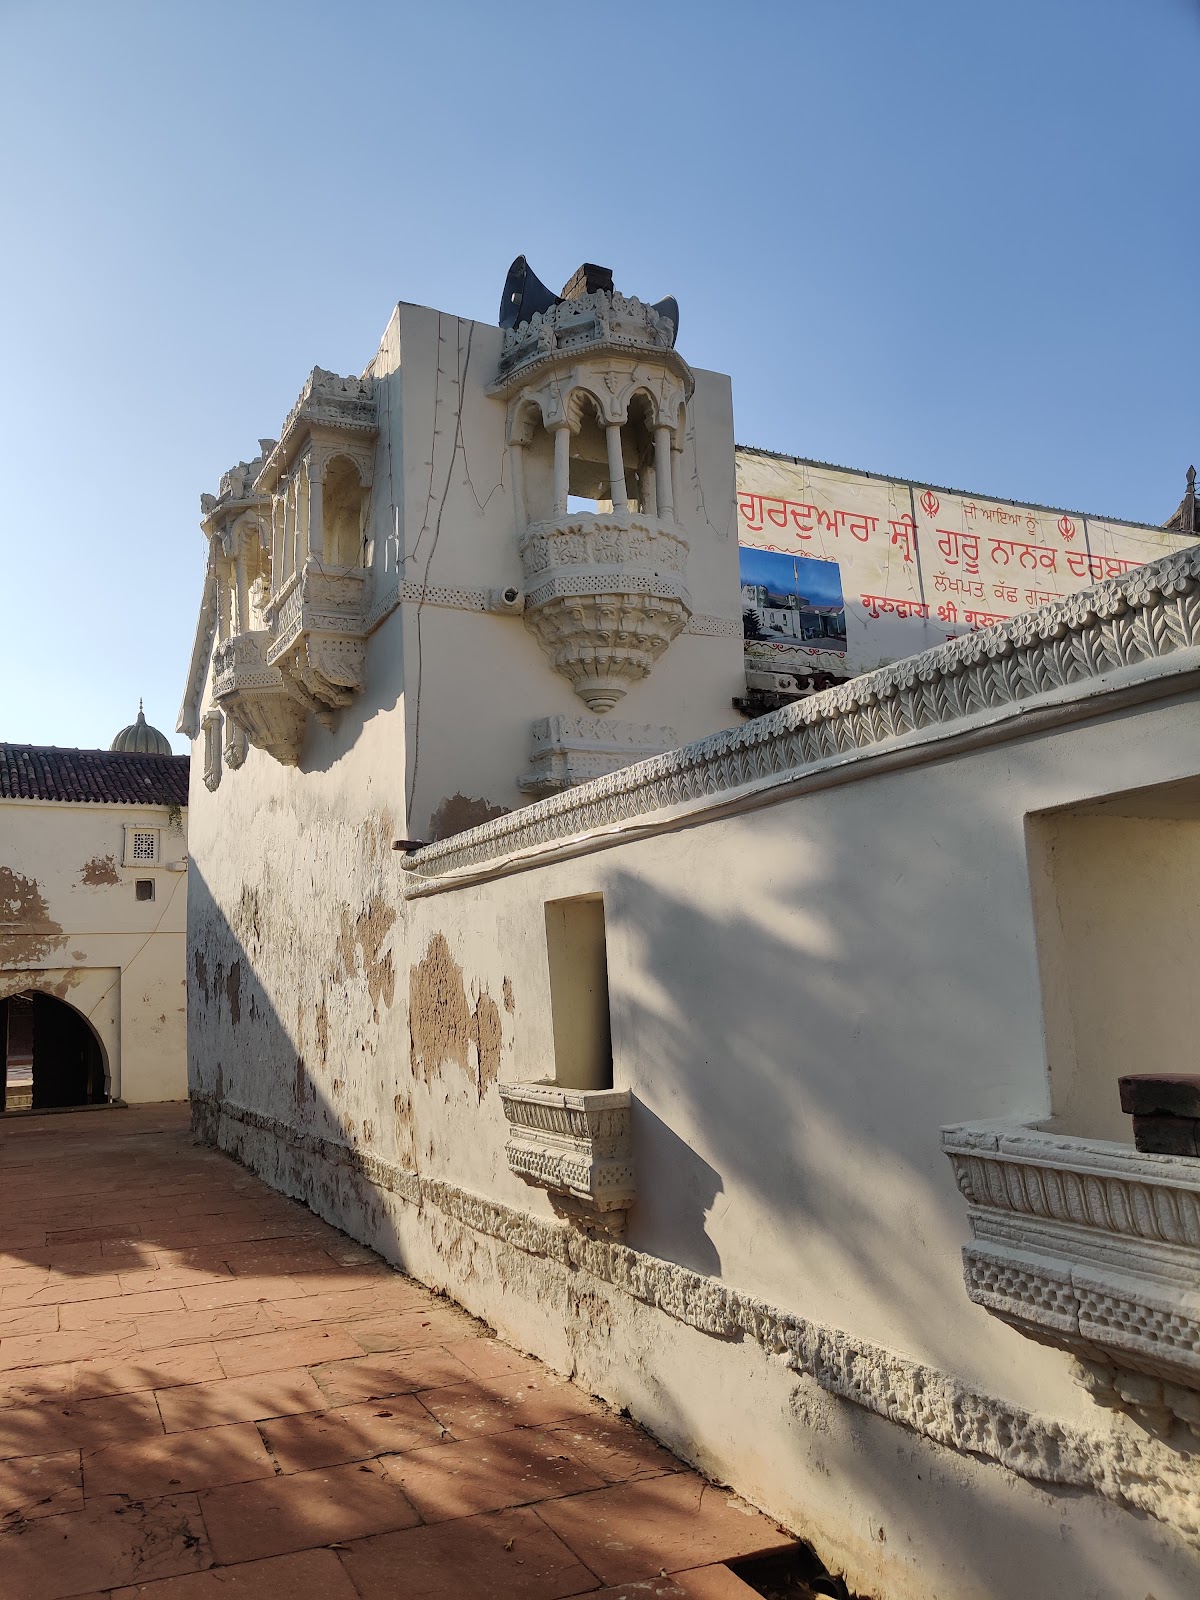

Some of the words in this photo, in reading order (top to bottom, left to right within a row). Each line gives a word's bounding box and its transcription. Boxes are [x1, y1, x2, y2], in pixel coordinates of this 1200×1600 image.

[963, 502, 977, 519] ਜੀ
[981, 507, 1022, 526] ਆਇਆ
[737, 491, 880, 542] ਗੁਰਦੁਆਰਾ
[936, 529, 980, 575] ਗੁਰੂ
[988, 538, 1057, 573] ਨਾਨਕ
[1065, 551, 1147, 580] ਦਰਬਾ
[933, 570, 984, 598] ਲੱਖਪਤ
[992, 580, 1018, 603] ਕੱਛ
[860, 594, 930, 619] गुरुद्वारा
[937, 600, 958, 623] श्री
